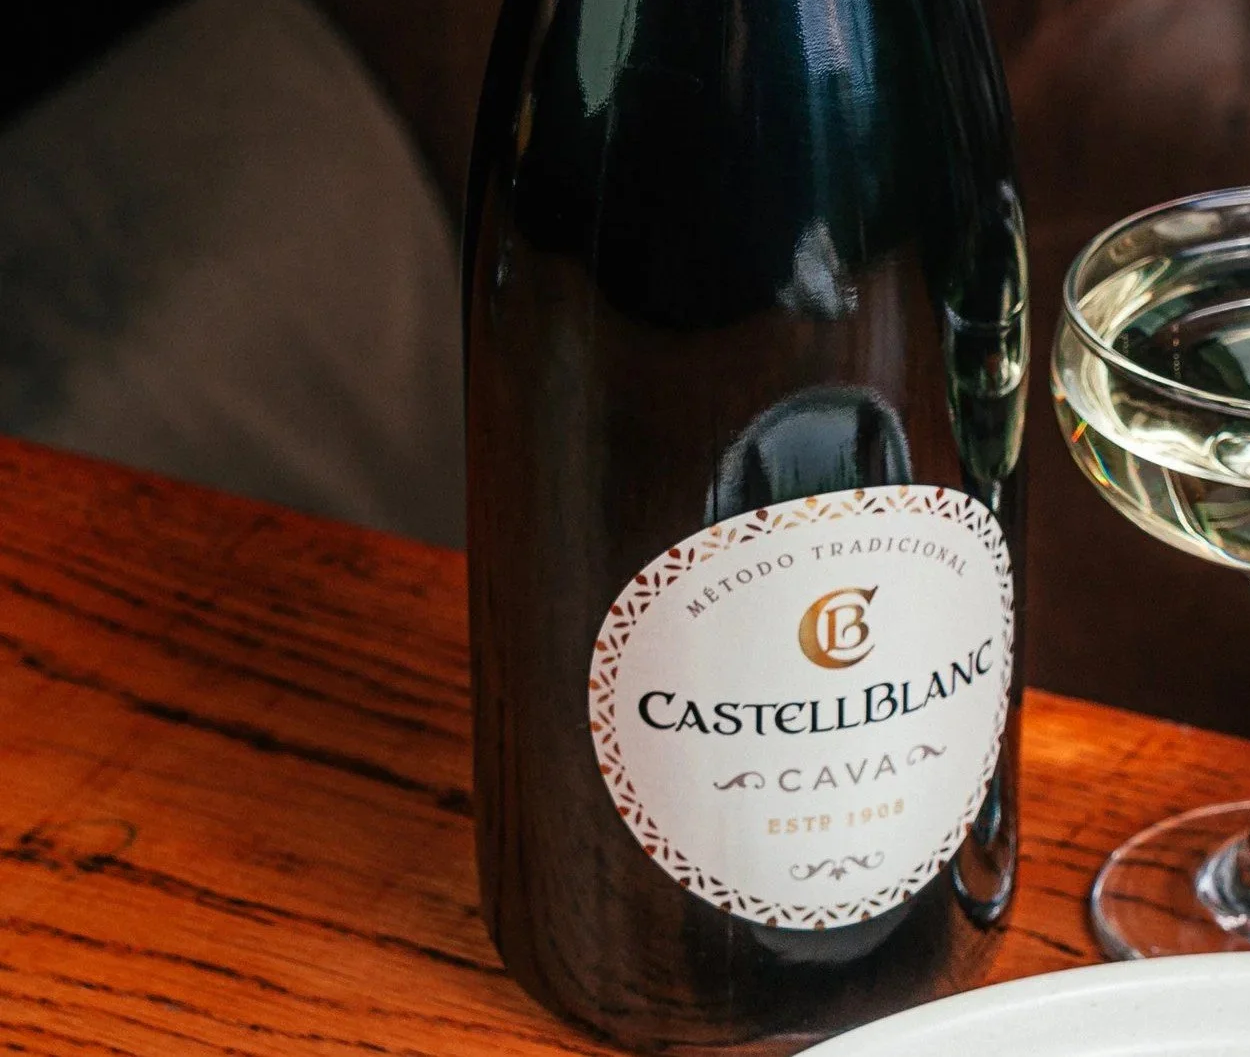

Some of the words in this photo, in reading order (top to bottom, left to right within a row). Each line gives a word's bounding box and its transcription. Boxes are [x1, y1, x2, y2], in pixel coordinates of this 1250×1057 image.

[685, 553, 794, 619] MÉTODO
[811, 537, 968, 576] TRADICIONAL
[777, 753, 897, 793] CAVA
[845, 797, 905, 827] 1908
